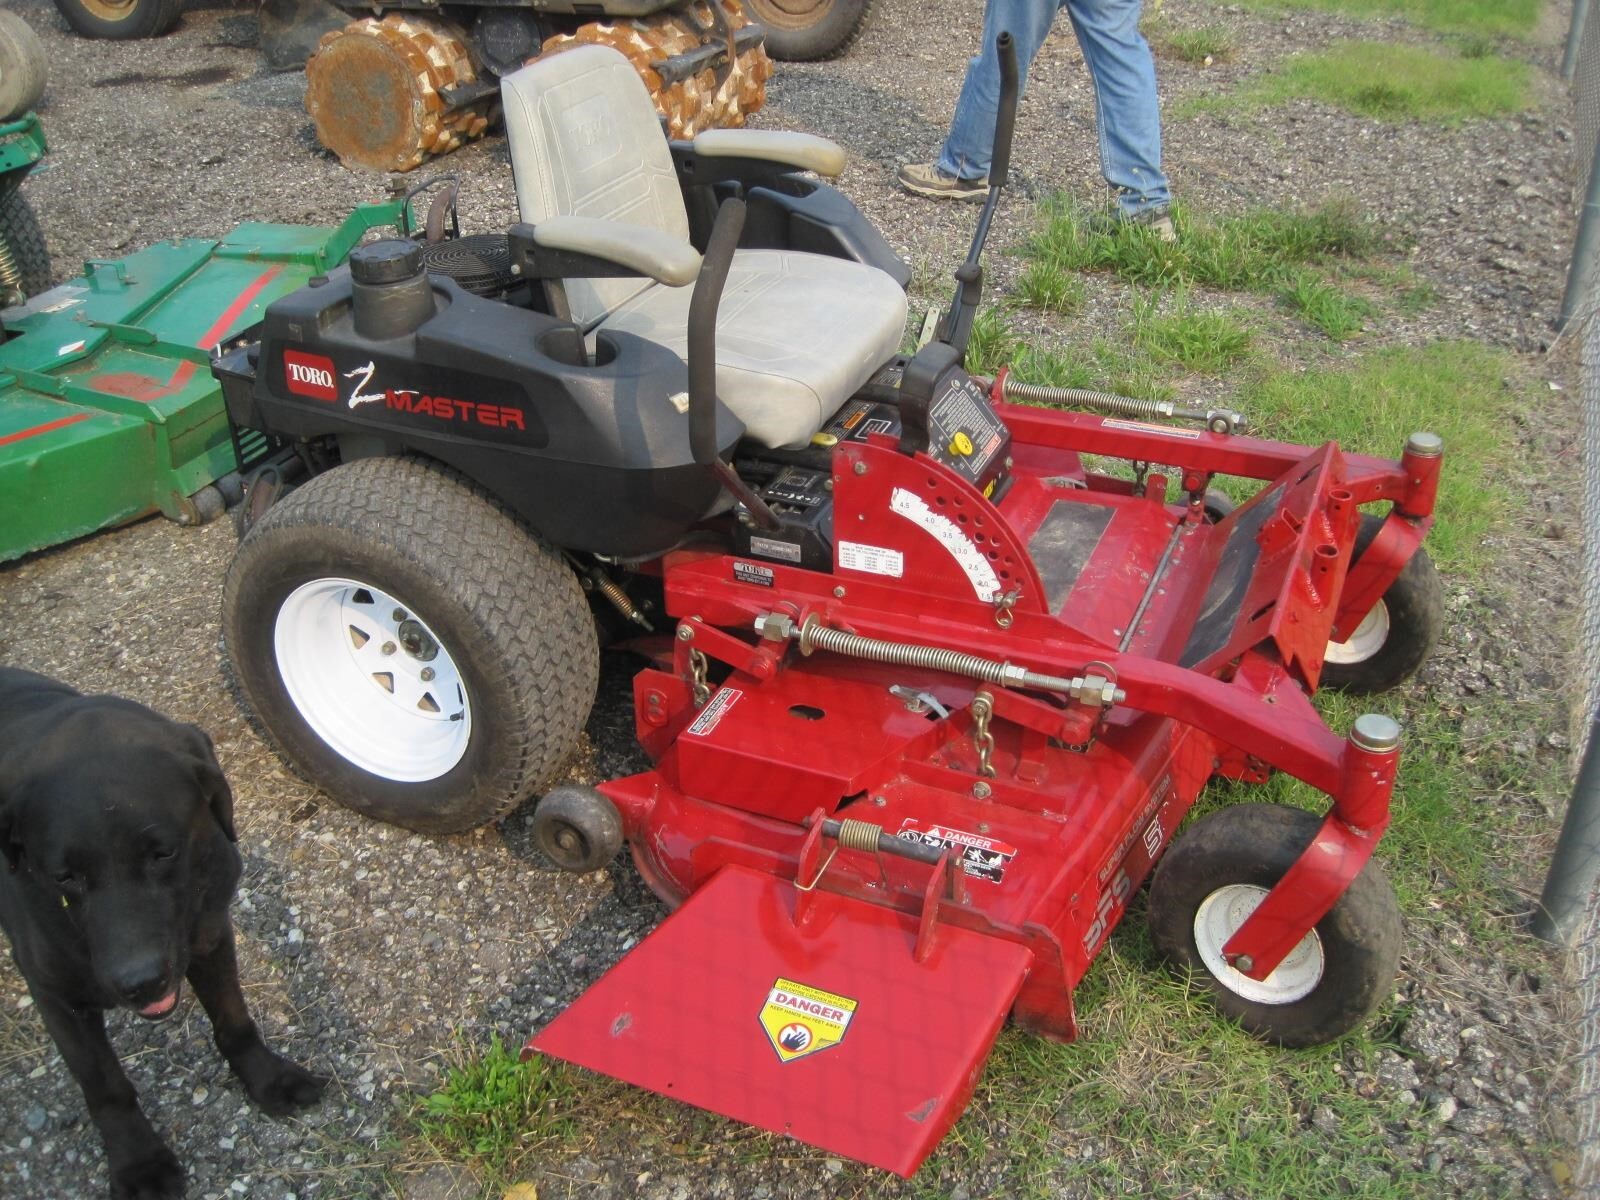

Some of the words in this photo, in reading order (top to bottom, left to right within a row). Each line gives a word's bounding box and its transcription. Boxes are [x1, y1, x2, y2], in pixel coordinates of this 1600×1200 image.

[288, 362, 334, 388] TORO
[385, 389, 526, 431] MASTER
[899, 501, 910, 509] 4.5
[925, 515, 935, 524] 4.0
[942, 531, 953, 539] 3.5
[957, 547, 968, 555] 3.0
[968, 563, 979, 571] 2.5
[944, 831, 992, 849] DANGER
[1100, 843, 1124, 882] SUPER
[1124, 814, 1145, 846] FLOW
[780, 979, 801, 989] OPERATE
[814, 988, 826, 996] WITH
[775, 992, 844, 1021] DANGER
[770, 1004, 783, 1012] KEEP
[784, 1008, 801, 1018] HANDS
[812, 1017, 824, 1025] FEET
[825, 1021, 841, 1030] AWAY
